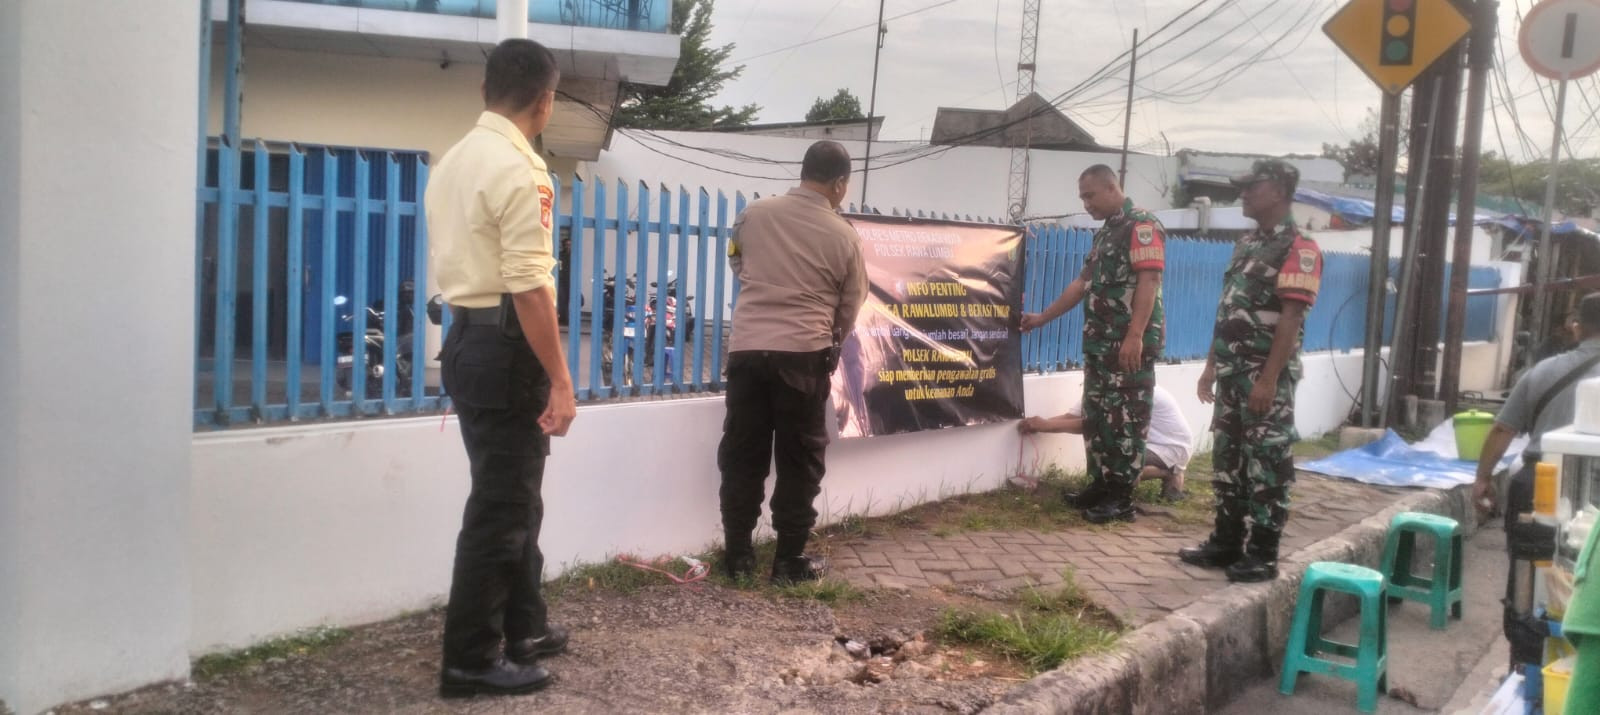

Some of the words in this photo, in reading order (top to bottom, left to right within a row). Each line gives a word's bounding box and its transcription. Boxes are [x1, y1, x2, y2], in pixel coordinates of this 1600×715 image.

[907, 282, 928, 297] INFO
[930, 282, 967, 297] PENTING
[902, 303, 958, 318] RAWALUMBU
[960, 303, 967, 317] &
[903, 349, 929, 363] POLSEK
[878, 368, 894, 386] siap
[937, 367, 978, 384] pengawalan
[905, 386, 925, 401] untuk
[956, 383, 975, 398] Anda
